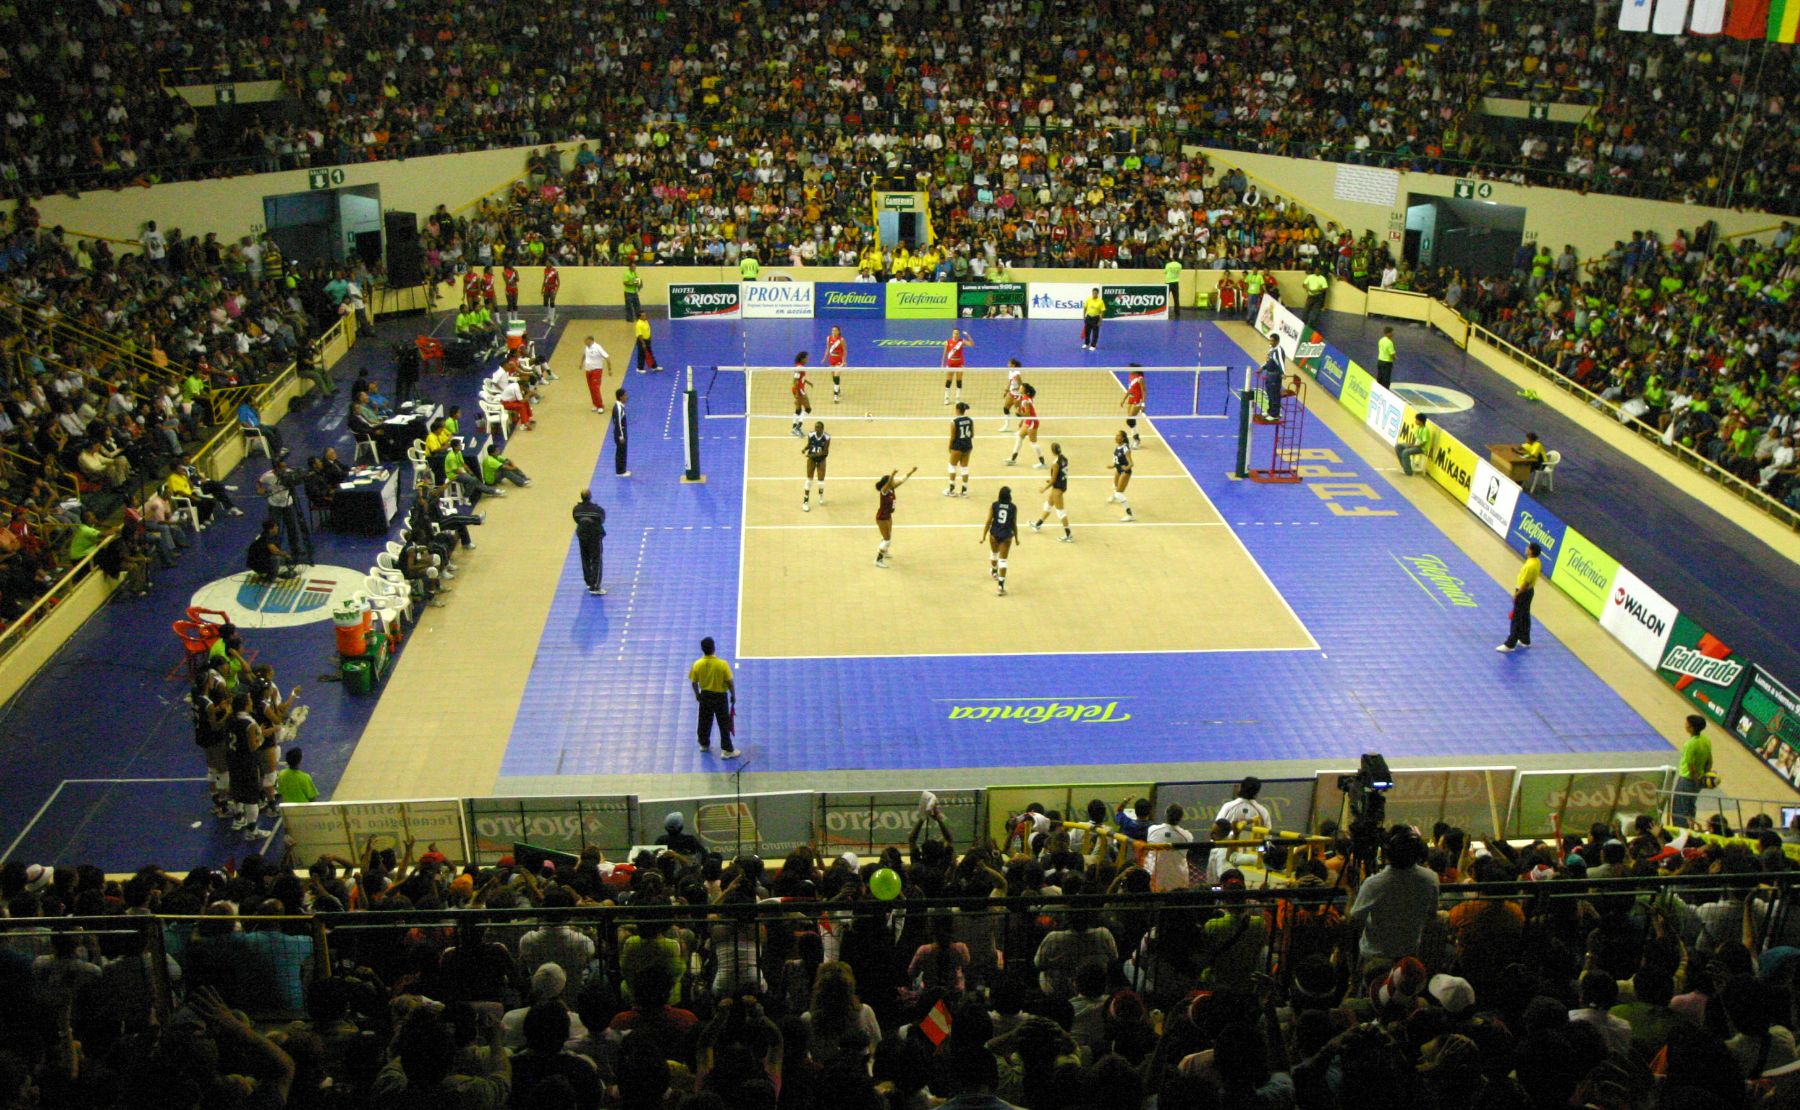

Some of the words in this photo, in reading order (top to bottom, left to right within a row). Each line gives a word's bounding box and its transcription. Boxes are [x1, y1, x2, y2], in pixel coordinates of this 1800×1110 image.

[333, 170, 342, 184] 1
[1479, 184, 1491, 197] 4
[748, 286, 811, 302] PRONAA
[997, 509, 1008, 524] 9
[1624, 594, 1666, 638] WALON
[1664, 647, 1739, 684] Gatorade
